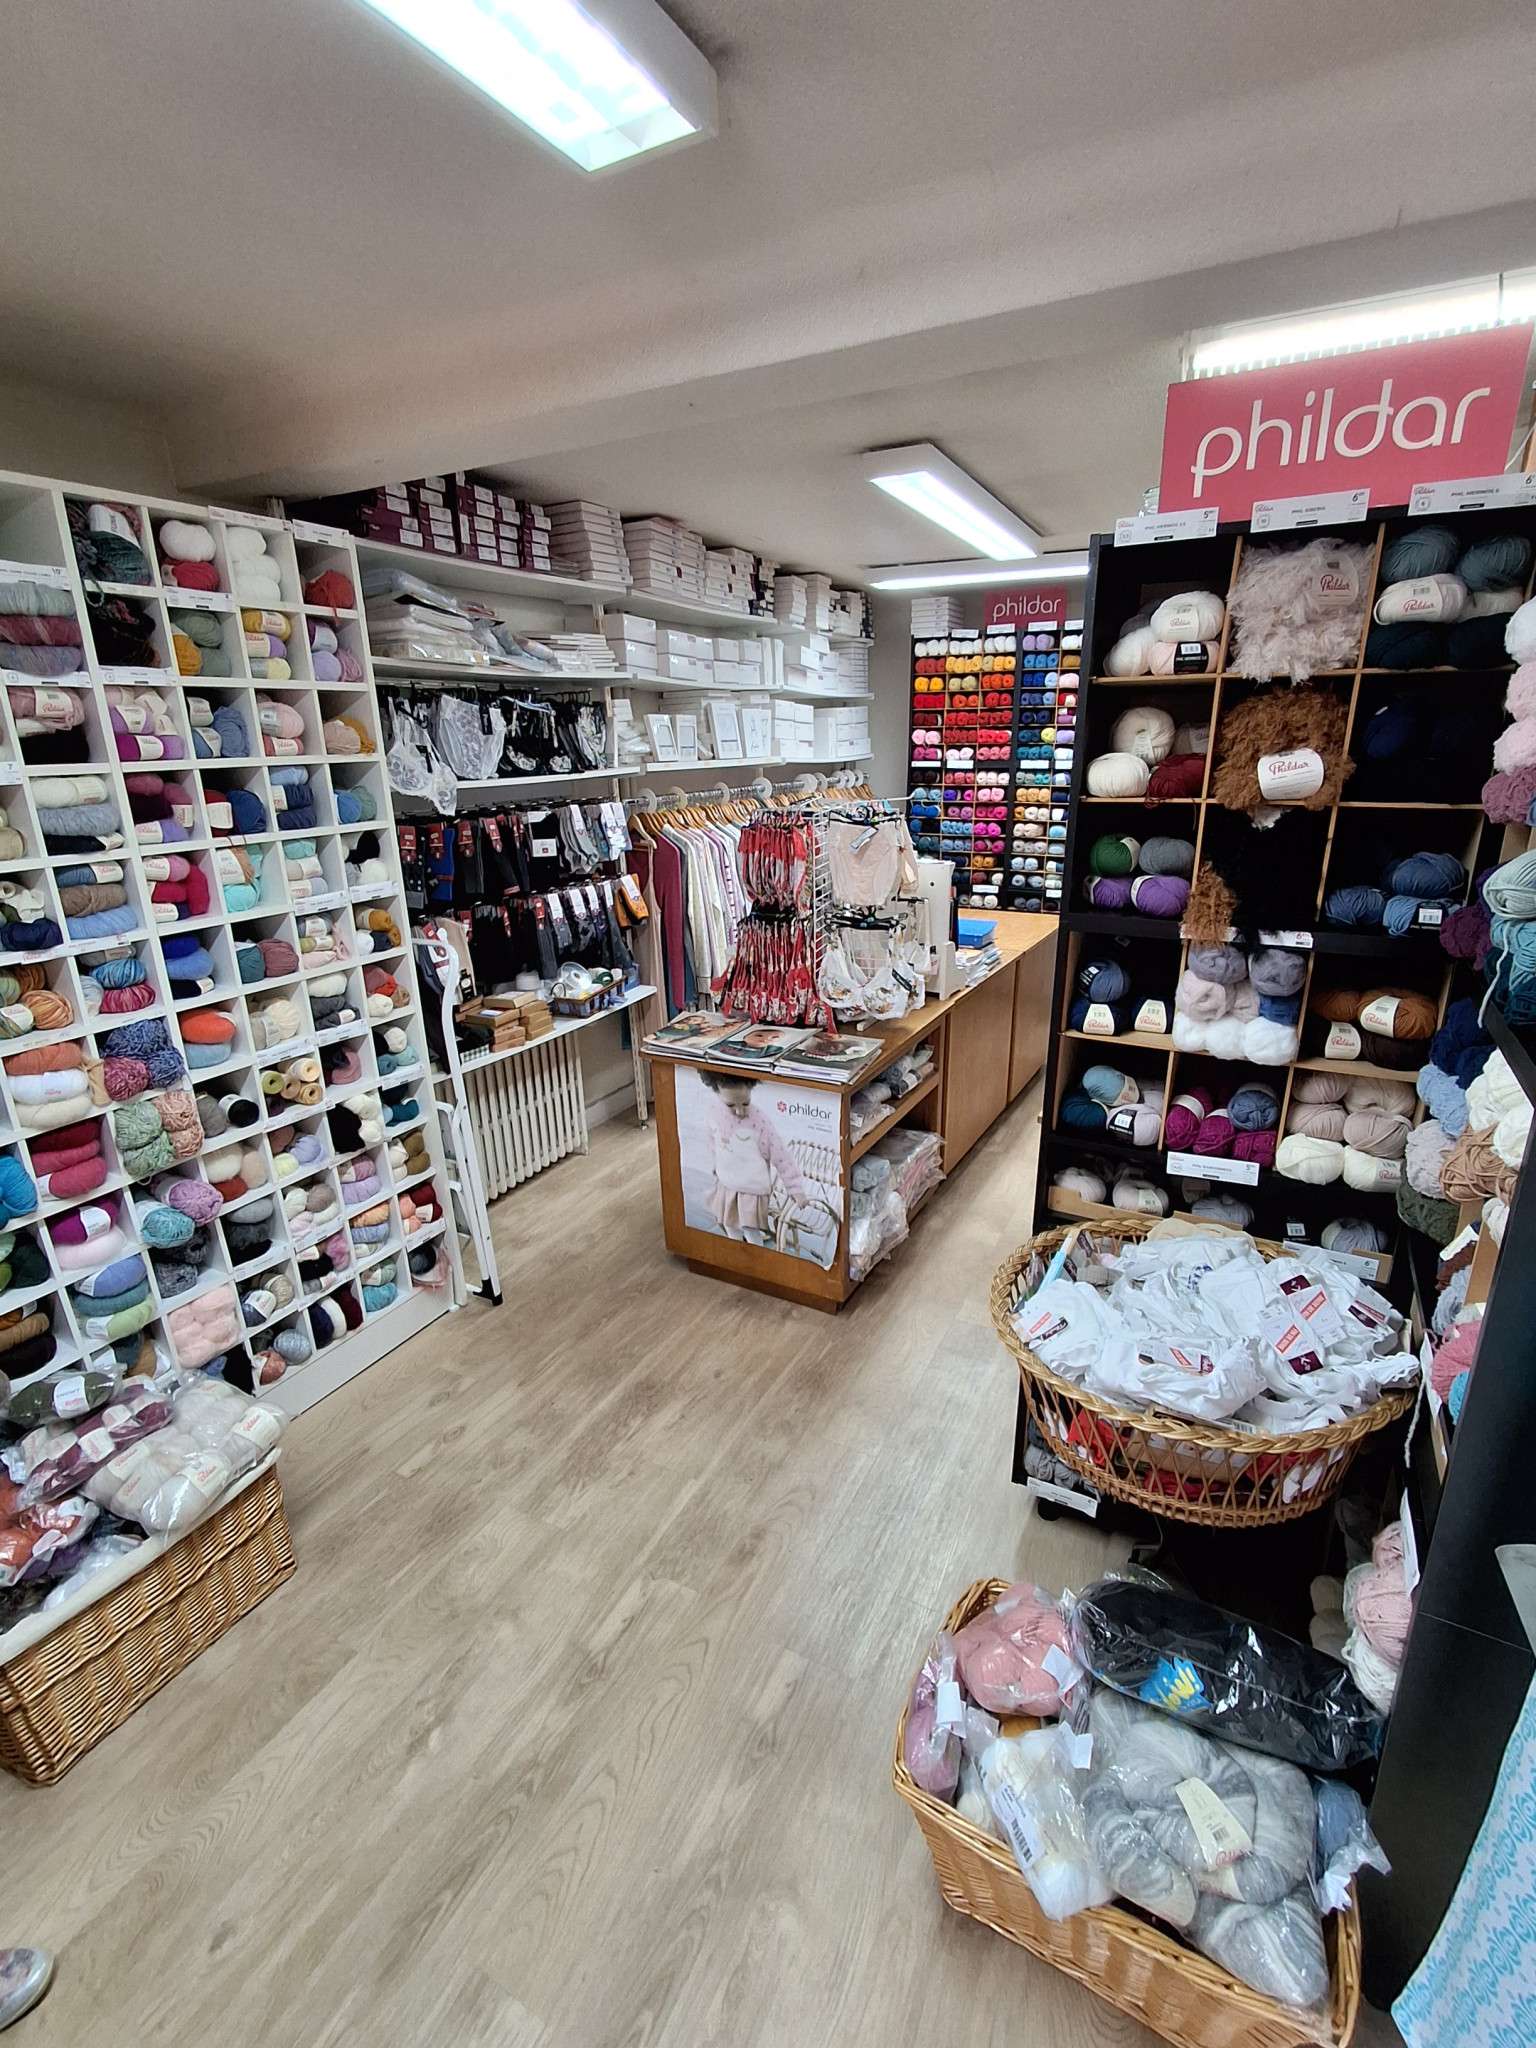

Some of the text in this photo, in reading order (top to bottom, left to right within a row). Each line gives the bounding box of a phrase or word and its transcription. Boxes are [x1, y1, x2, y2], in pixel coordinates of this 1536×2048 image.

[1191, 379, 1490, 497] phildar
[1320, 574, 1350, 593] Phildar
[993, 594, 1062, 623] phildar
[1403, 599, 1434, 613] Phildar
[1268, 760, 1309, 776] Phildar
[788, 1103, 833, 1120] phildar
